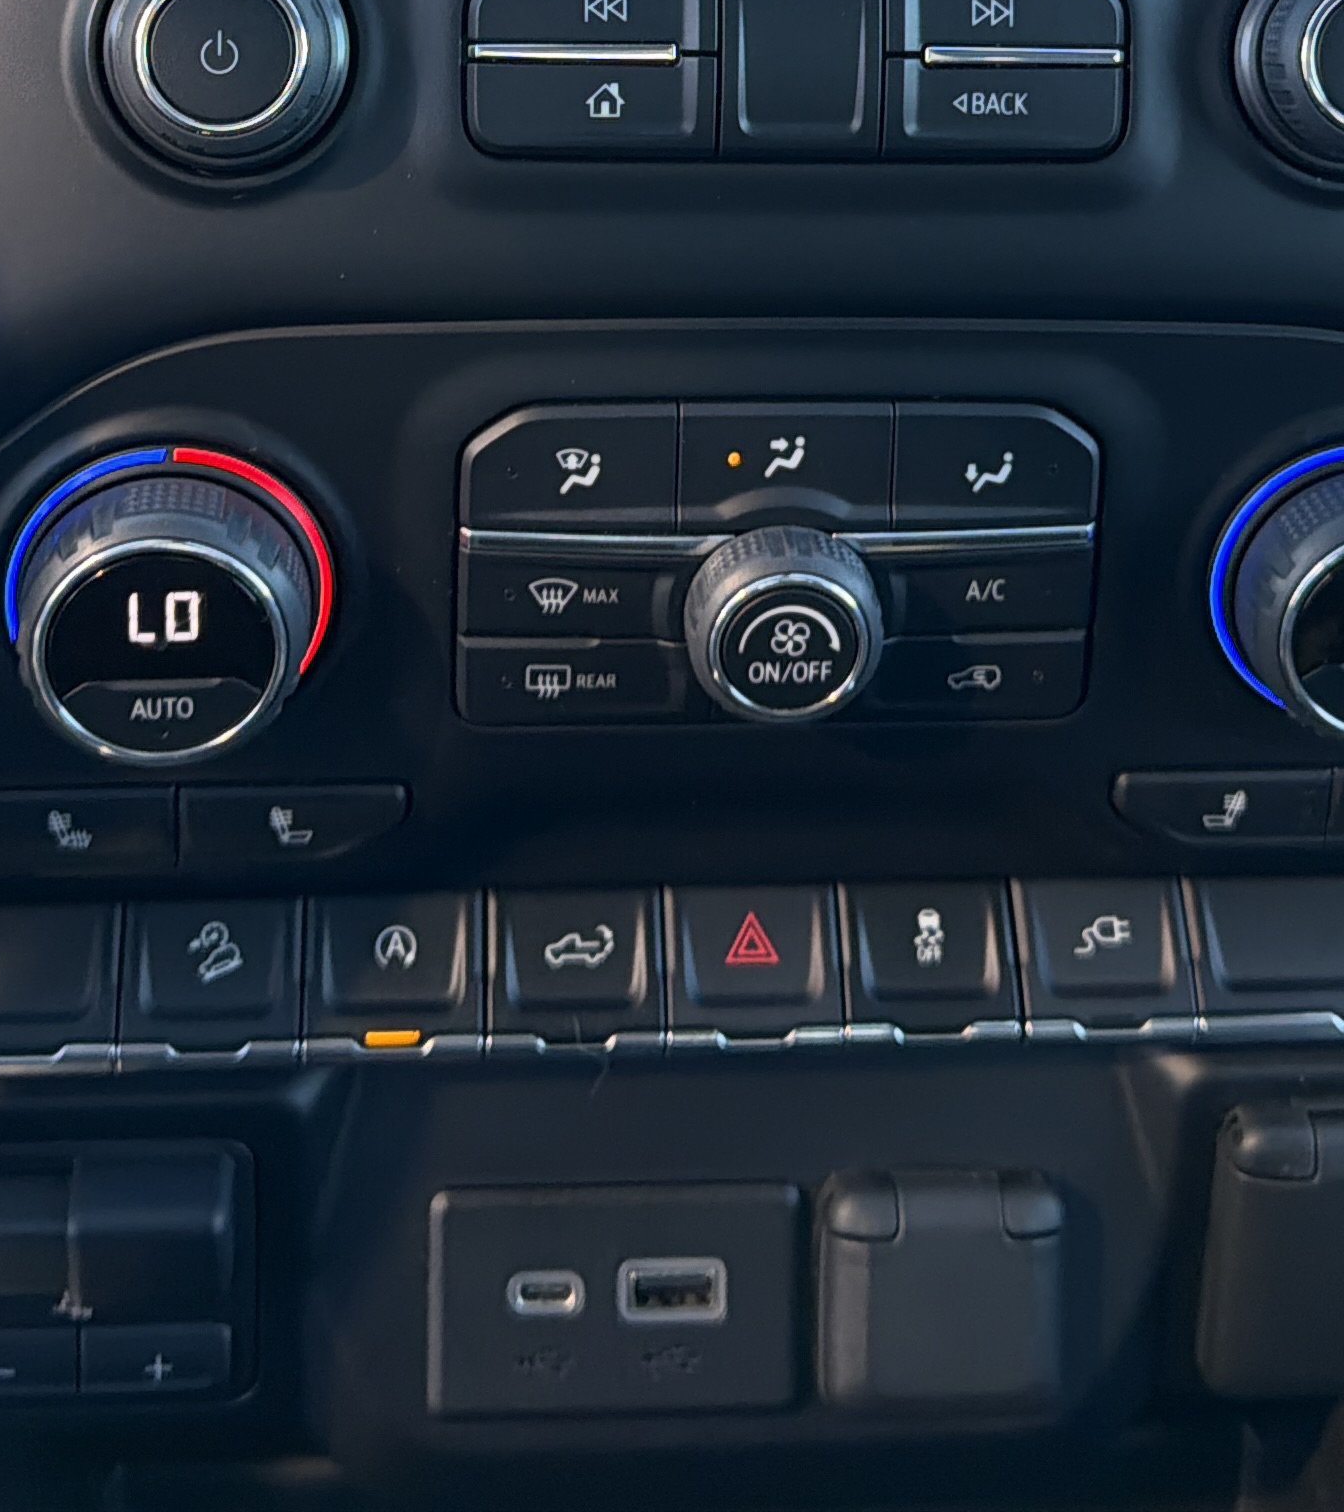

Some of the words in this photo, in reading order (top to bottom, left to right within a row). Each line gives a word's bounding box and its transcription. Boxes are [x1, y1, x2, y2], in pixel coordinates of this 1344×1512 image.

[971, 92, 1028, 116] BACK
[582, 588, 619, 604] MAX
[965, 578, 1005, 601] A/C
[575, 673, 617, 689] REAR
[748, 660, 833, 684] ON/OFF
[130, 696, 194, 720] AUTO
